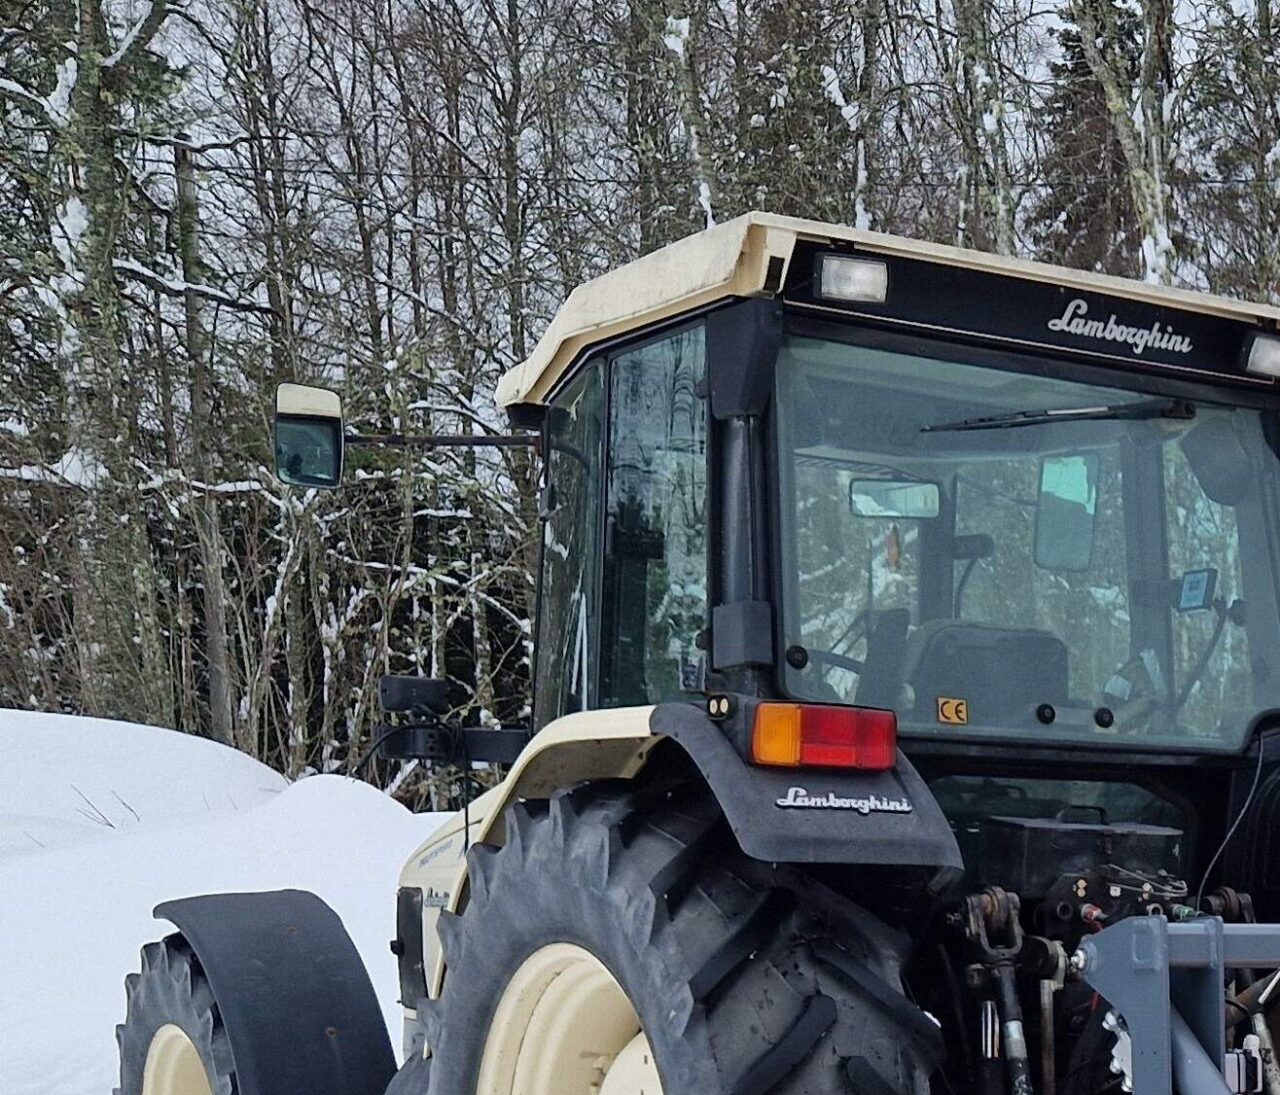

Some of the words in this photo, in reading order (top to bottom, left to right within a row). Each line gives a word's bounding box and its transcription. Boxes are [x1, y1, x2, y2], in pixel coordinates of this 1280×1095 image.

[1048, 299, 1194, 354] Lamborghini
[940, 700, 966, 722] CE
[776, 787, 913, 814] Lamborghini
